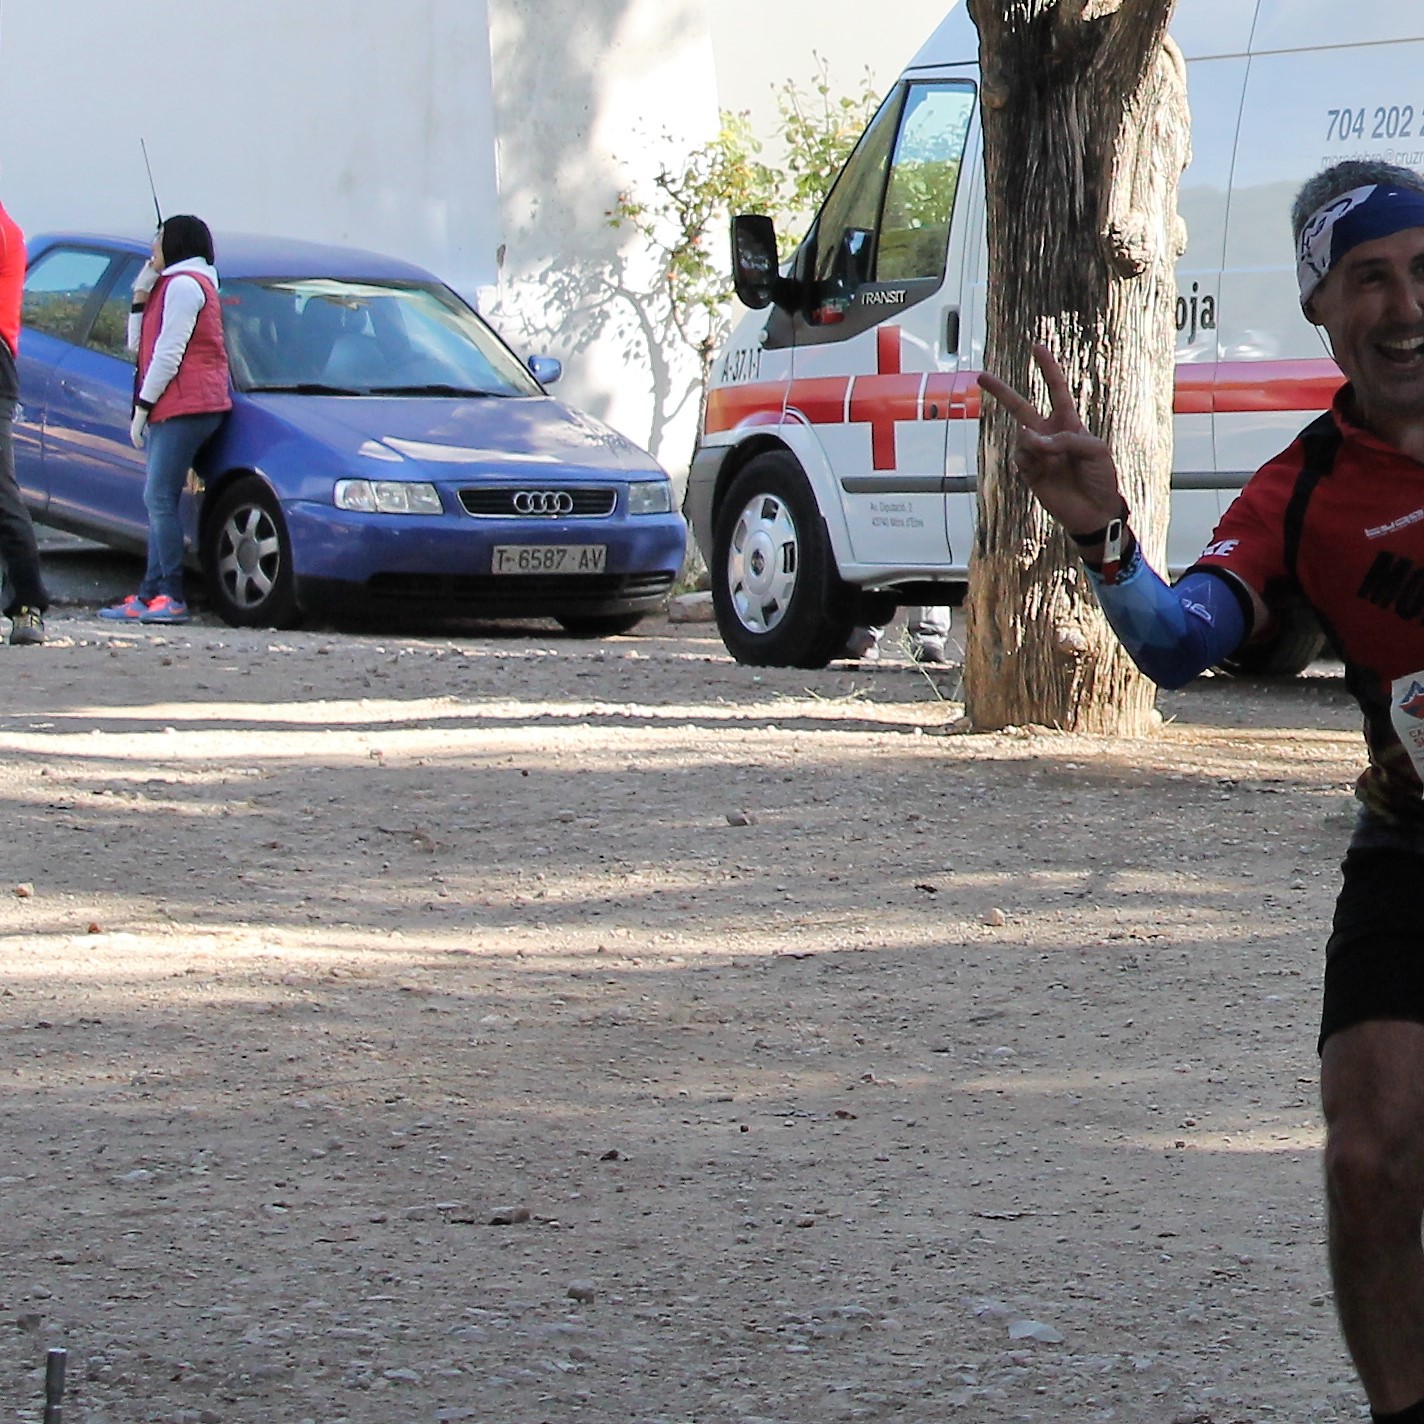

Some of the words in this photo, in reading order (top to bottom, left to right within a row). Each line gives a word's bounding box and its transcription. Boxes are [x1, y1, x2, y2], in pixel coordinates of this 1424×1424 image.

[1326, 107, 1366, 142] 704
[1371, 104, 1414, 139] 202
[862, 289, 906, 305] TRANSIT
[1175, 282, 1216, 344] oja
